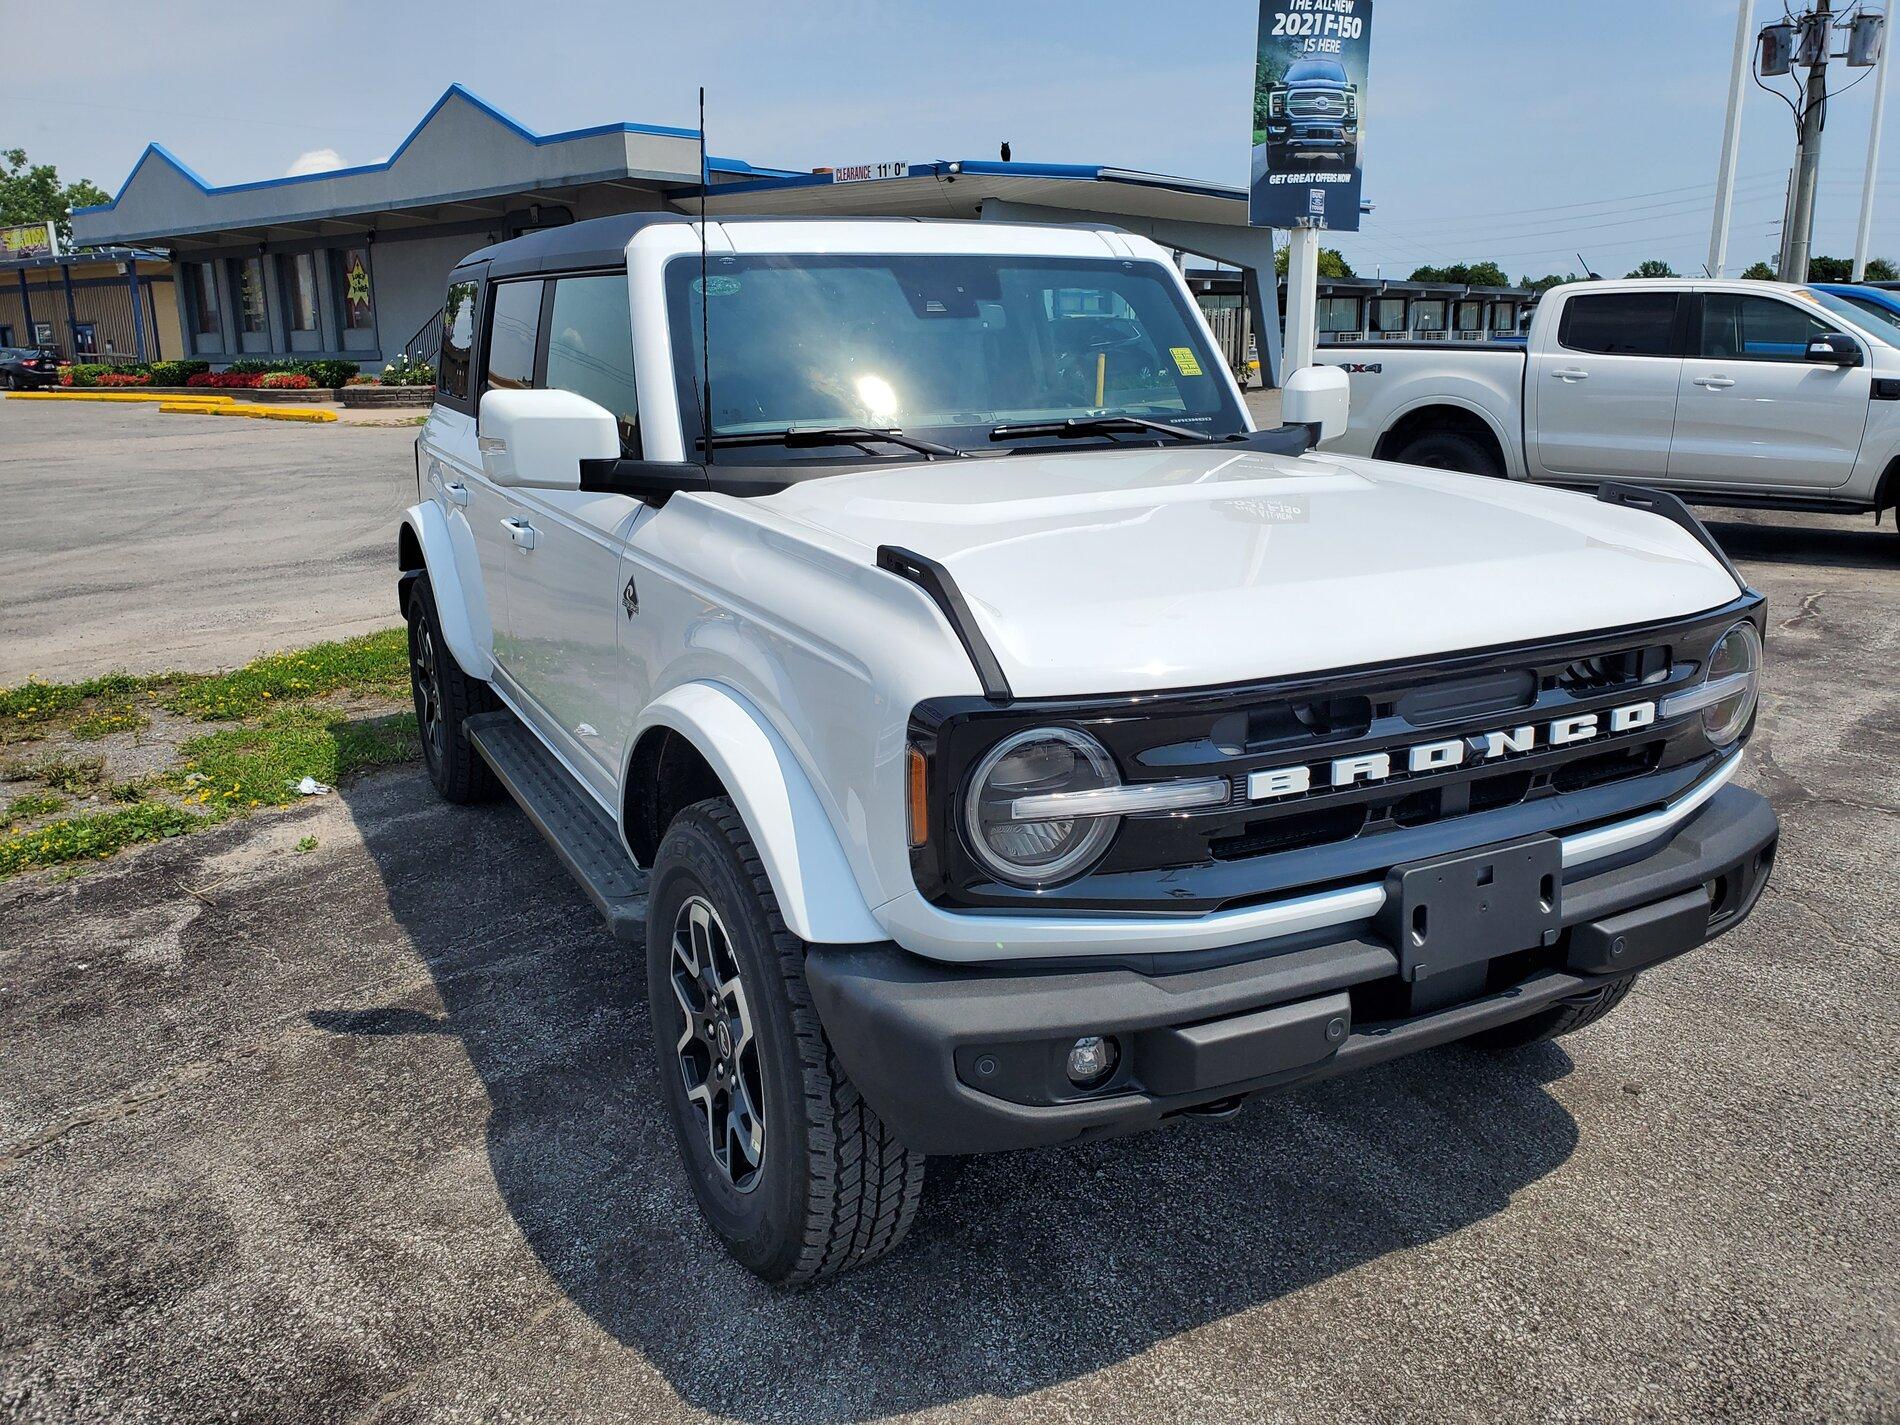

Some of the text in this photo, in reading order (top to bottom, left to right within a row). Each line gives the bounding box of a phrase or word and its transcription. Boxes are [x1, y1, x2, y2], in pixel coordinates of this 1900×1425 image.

[1290, 0, 1354, 14] THE ALL-NEW
[1271, 13, 1362, 39] 2021 F-150
[1304, 38, 1341, 53] IS HERE
[836, 165, 871, 181] CLEARANCE
[877, 163, 891, 178] 11'
[1269, 172, 1351, 184] GET GREAT OFFERS NOW
[1247, 701, 1656, 801] BRONCO
